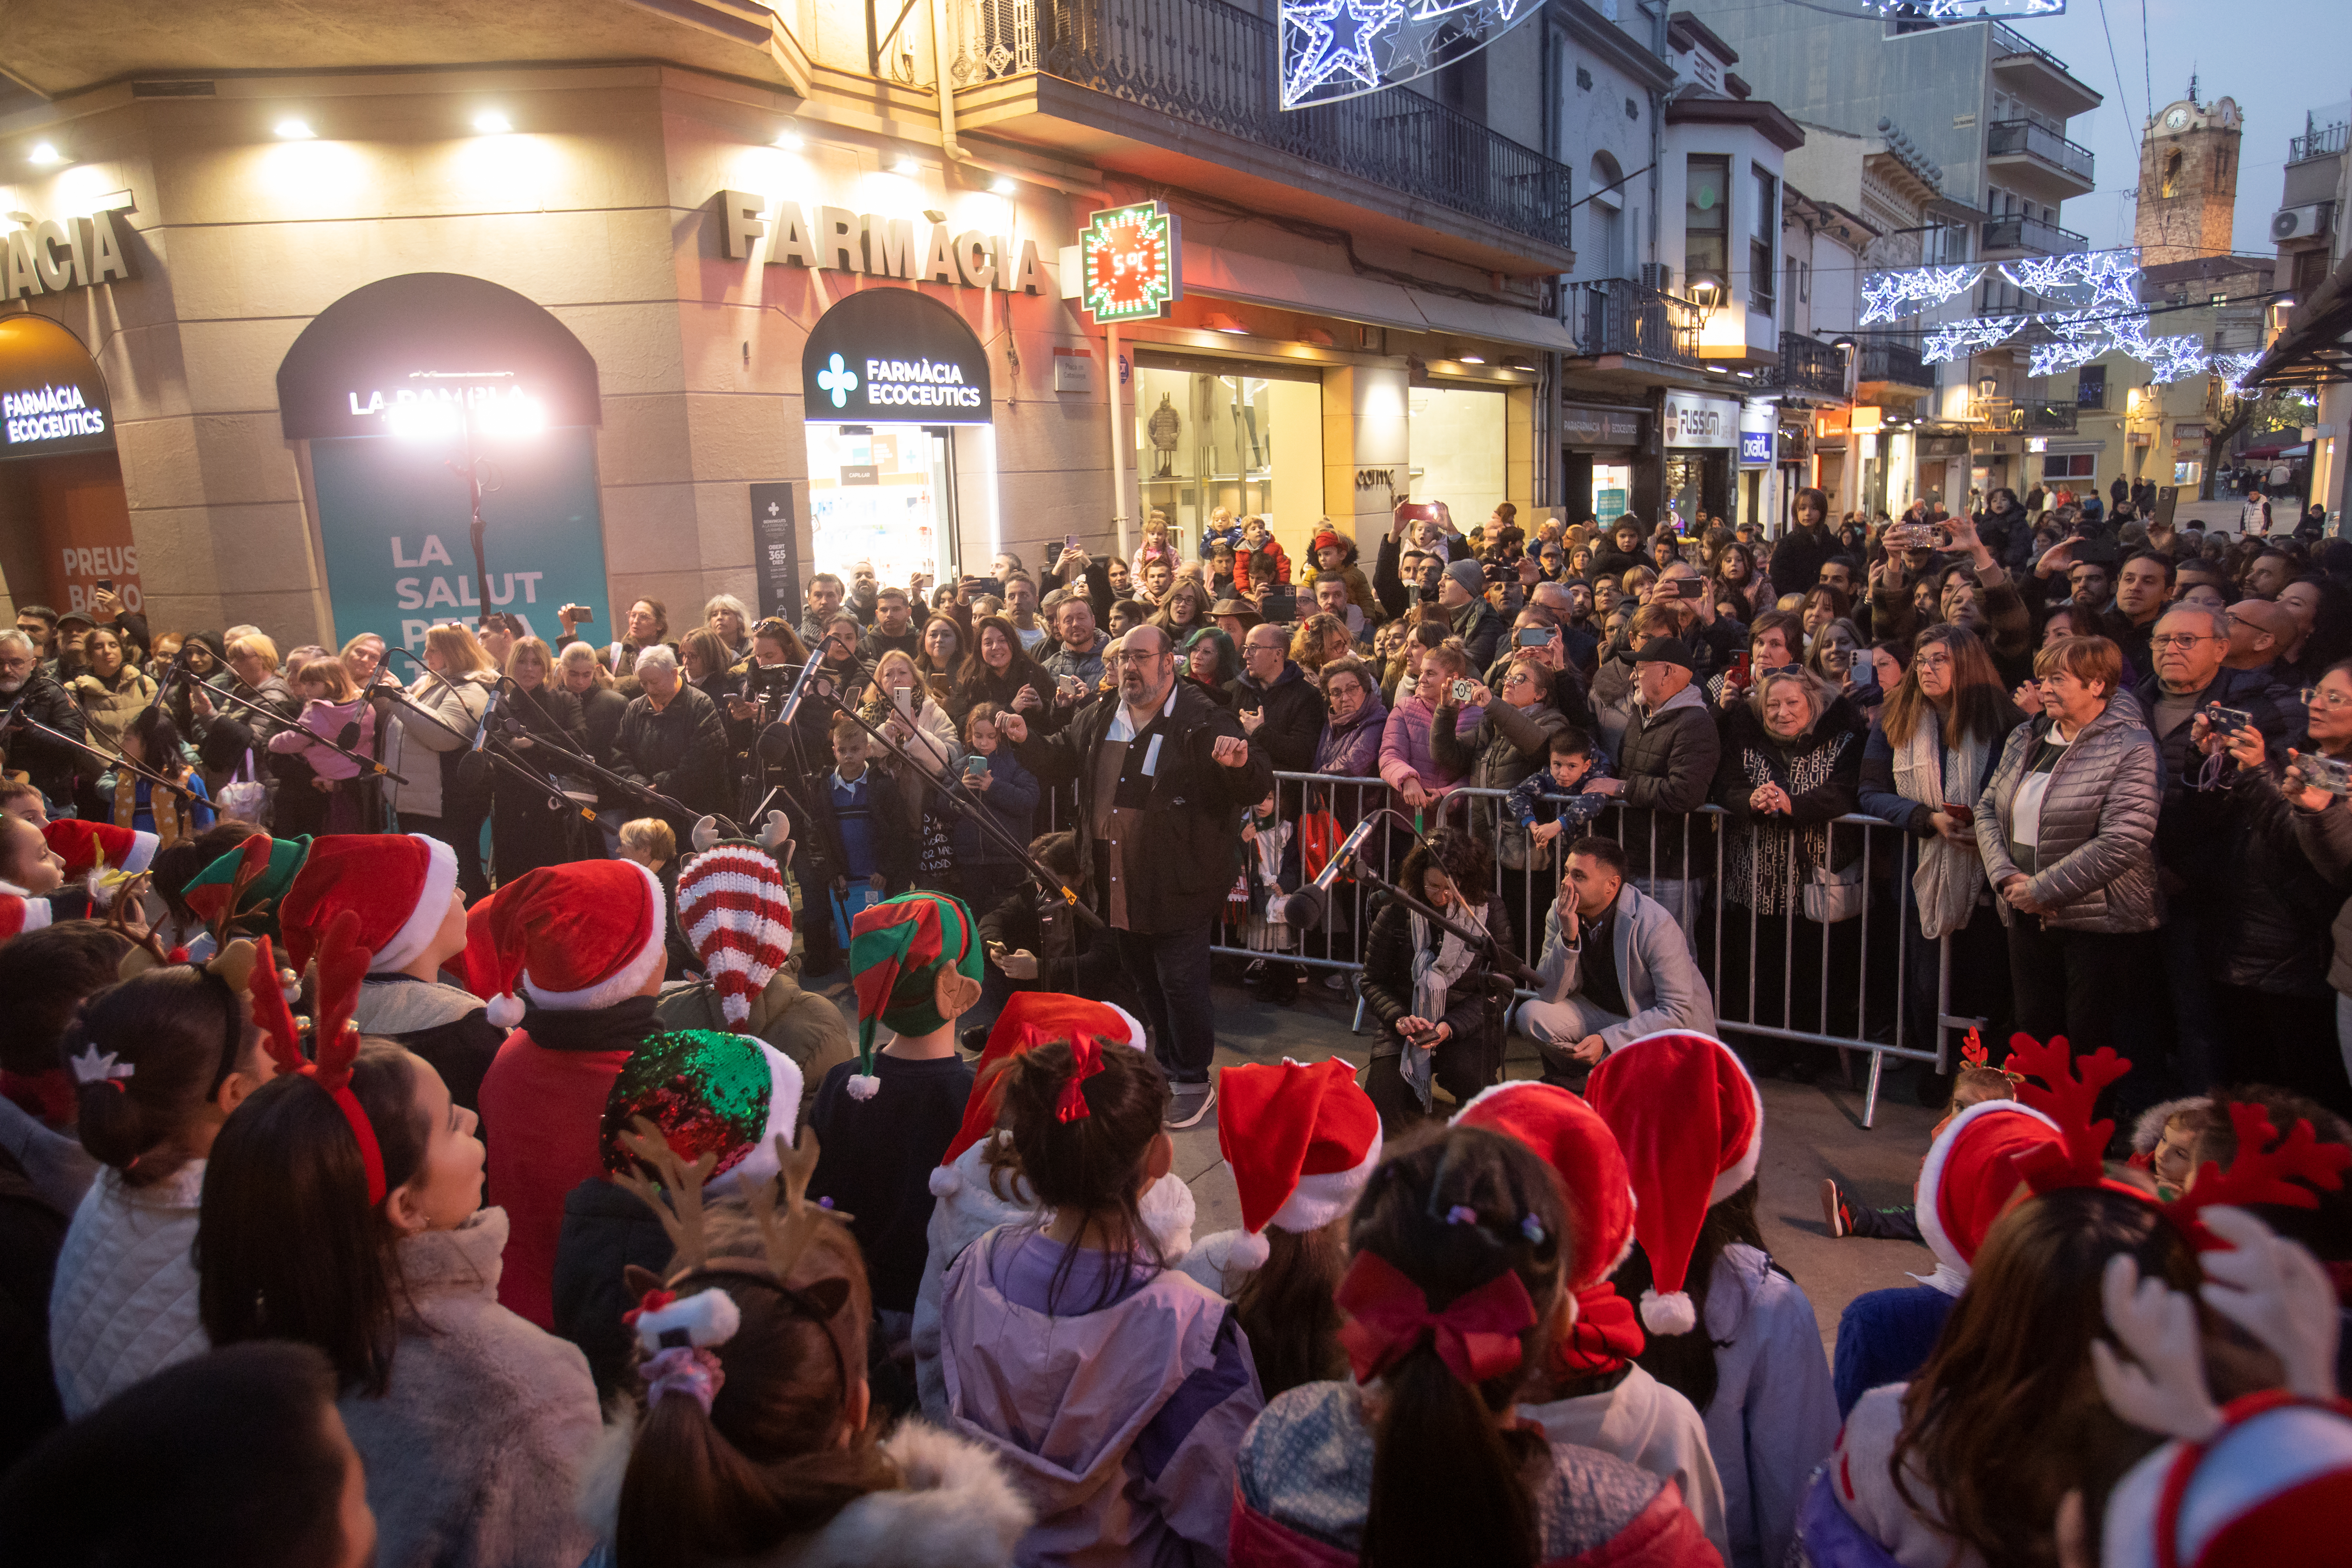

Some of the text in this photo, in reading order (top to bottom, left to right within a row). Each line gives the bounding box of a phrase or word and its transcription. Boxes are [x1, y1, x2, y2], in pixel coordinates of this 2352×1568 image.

[0, 211, 129, 301] ÀCIA
[719, 190, 1046, 296] FARMÀCIA
[867, 358, 963, 384] FARMÀCIA
[4, 383, 86, 418] FARMÀCIA
[349, 391, 385, 415] LA
[868, 384, 981, 407] ECOCEUTICS
[7, 409, 105, 443] ECOCEUTICS
[62, 546, 139, 576] PREUS
[391, 535, 453, 568] LA
[769, 550, 786, 560] 365
[395, 571, 543, 610] SALUT
